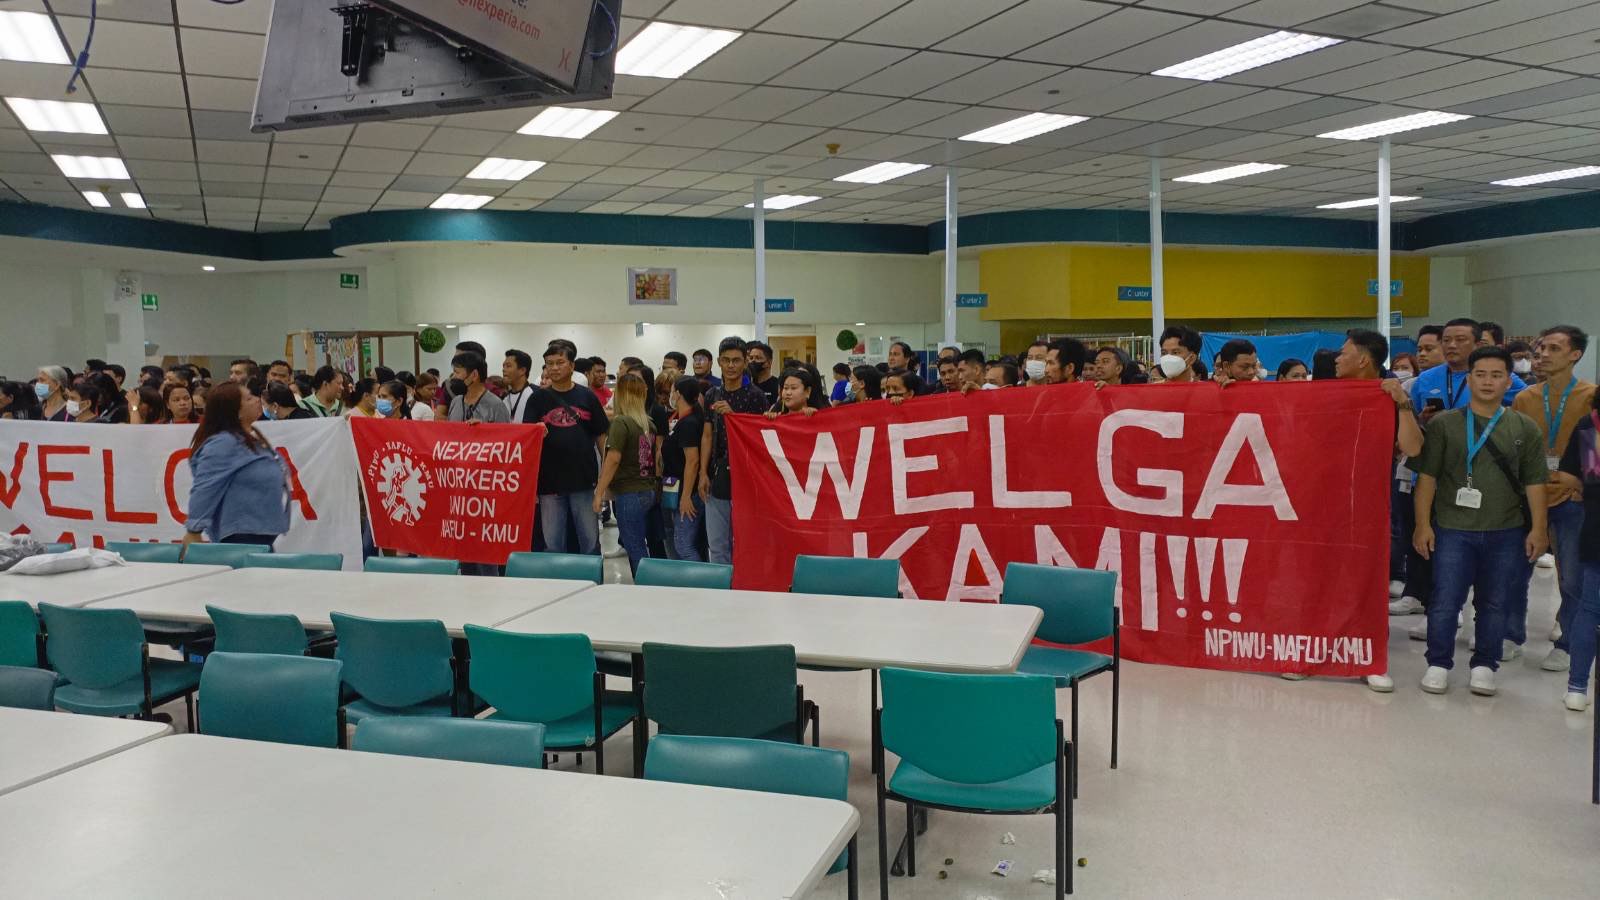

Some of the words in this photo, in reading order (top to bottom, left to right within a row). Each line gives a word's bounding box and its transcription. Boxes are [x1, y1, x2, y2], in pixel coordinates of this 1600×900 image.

[432, 440, 523, 464] NEXPERIA
[761, 409, 1299, 521] WELGA
[435, 467, 520, 492] WORKERS
[481, 523, 520, 544] KMU
[1204, 628, 1373, 666] NPIWU-NAFLU-KMU
